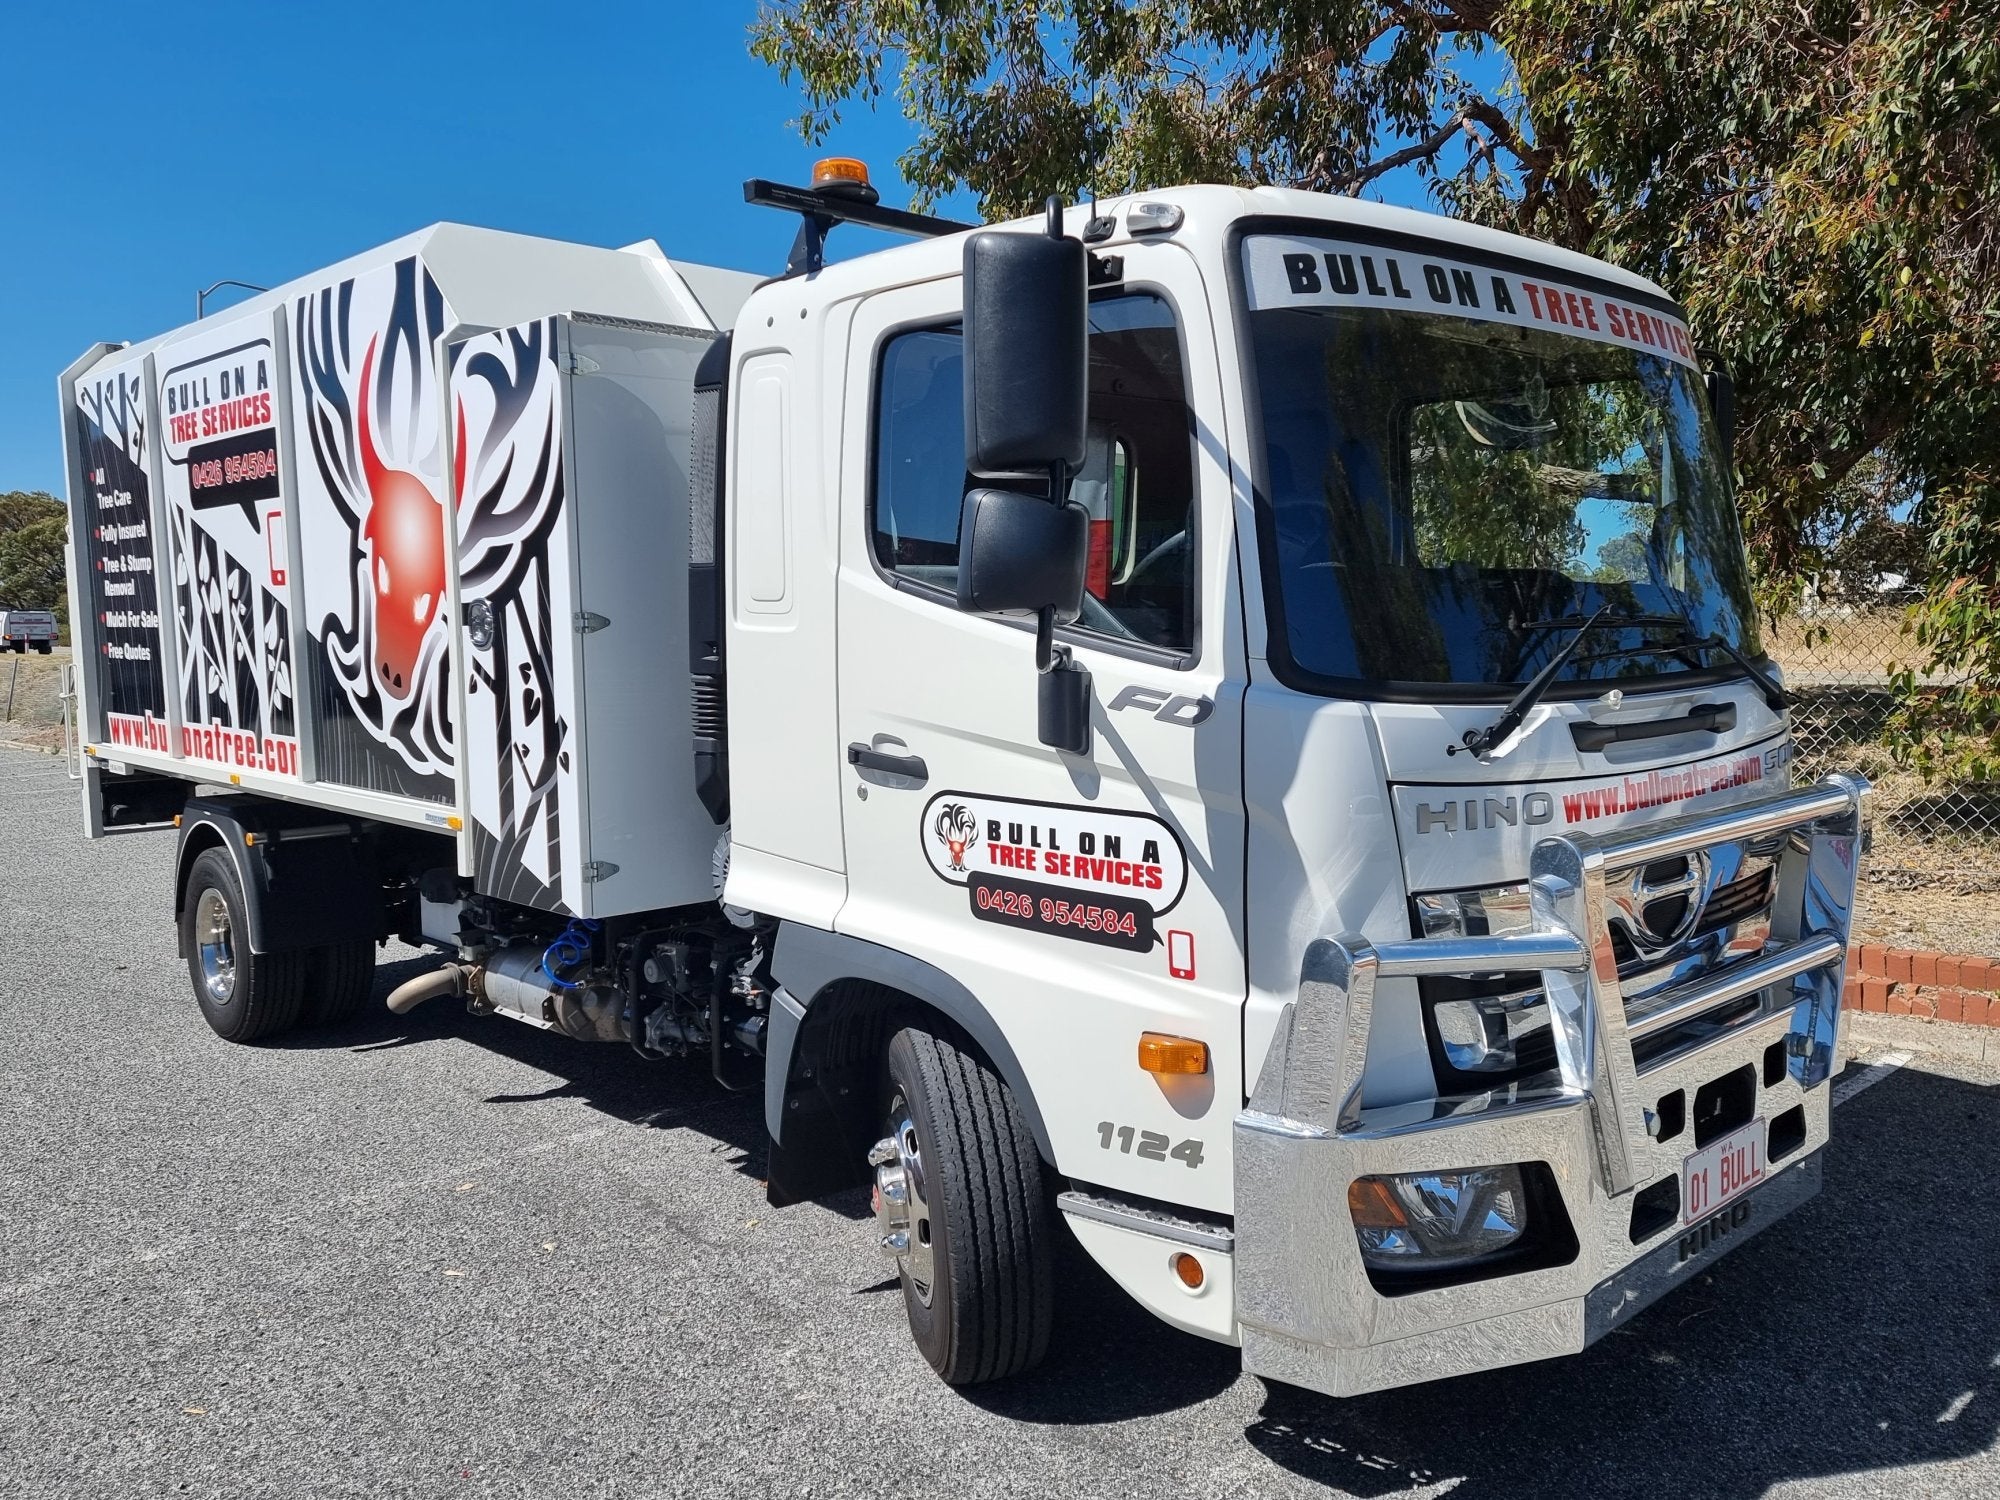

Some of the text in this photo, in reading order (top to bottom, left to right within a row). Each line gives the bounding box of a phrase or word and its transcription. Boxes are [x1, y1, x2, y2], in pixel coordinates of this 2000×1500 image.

[1283, 253, 1411, 298] BULL
[1422, 264, 1480, 308] ON
[1492, 276, 1517, 315] A
[1522, 282, 1600, 332] TREE
[168, 359, 269, 415] BULL ON A
[169, 392, 271, 445] TREE SERVICES
[95, 467, 105, 486] All
[192, 449, 276, 490] 0426 954584
[97, 489, 132, 509] Tree Care
[100, 519, 147, 545] Fully Insured
[102, 554, 152, 575] Tree & Stump
[104, 578, 135, 596] Removal
[105, 610, 159, 628] Mulch For Sale
[108, 642, 151, 661] Free Quotes
[1107, 684, 1216, 728] FD
[1562, 754, 1762, 824] www.bullonatree.com
[1416, 791, 1554, 834] HINO
[987, 819, 1161, 864] BULL ON A
[987, 843, 1163, 890] TREE SERVICES
[976, 886, 1137, 937] 0426 954584
[1097, 1121, 1205, 1169] 1124
[1720, 1140, 1734, 1155] WA
[1691, 1141, 1760, 1213] 01 BULL
[1678, 1199, 1750, 1262] HINO
